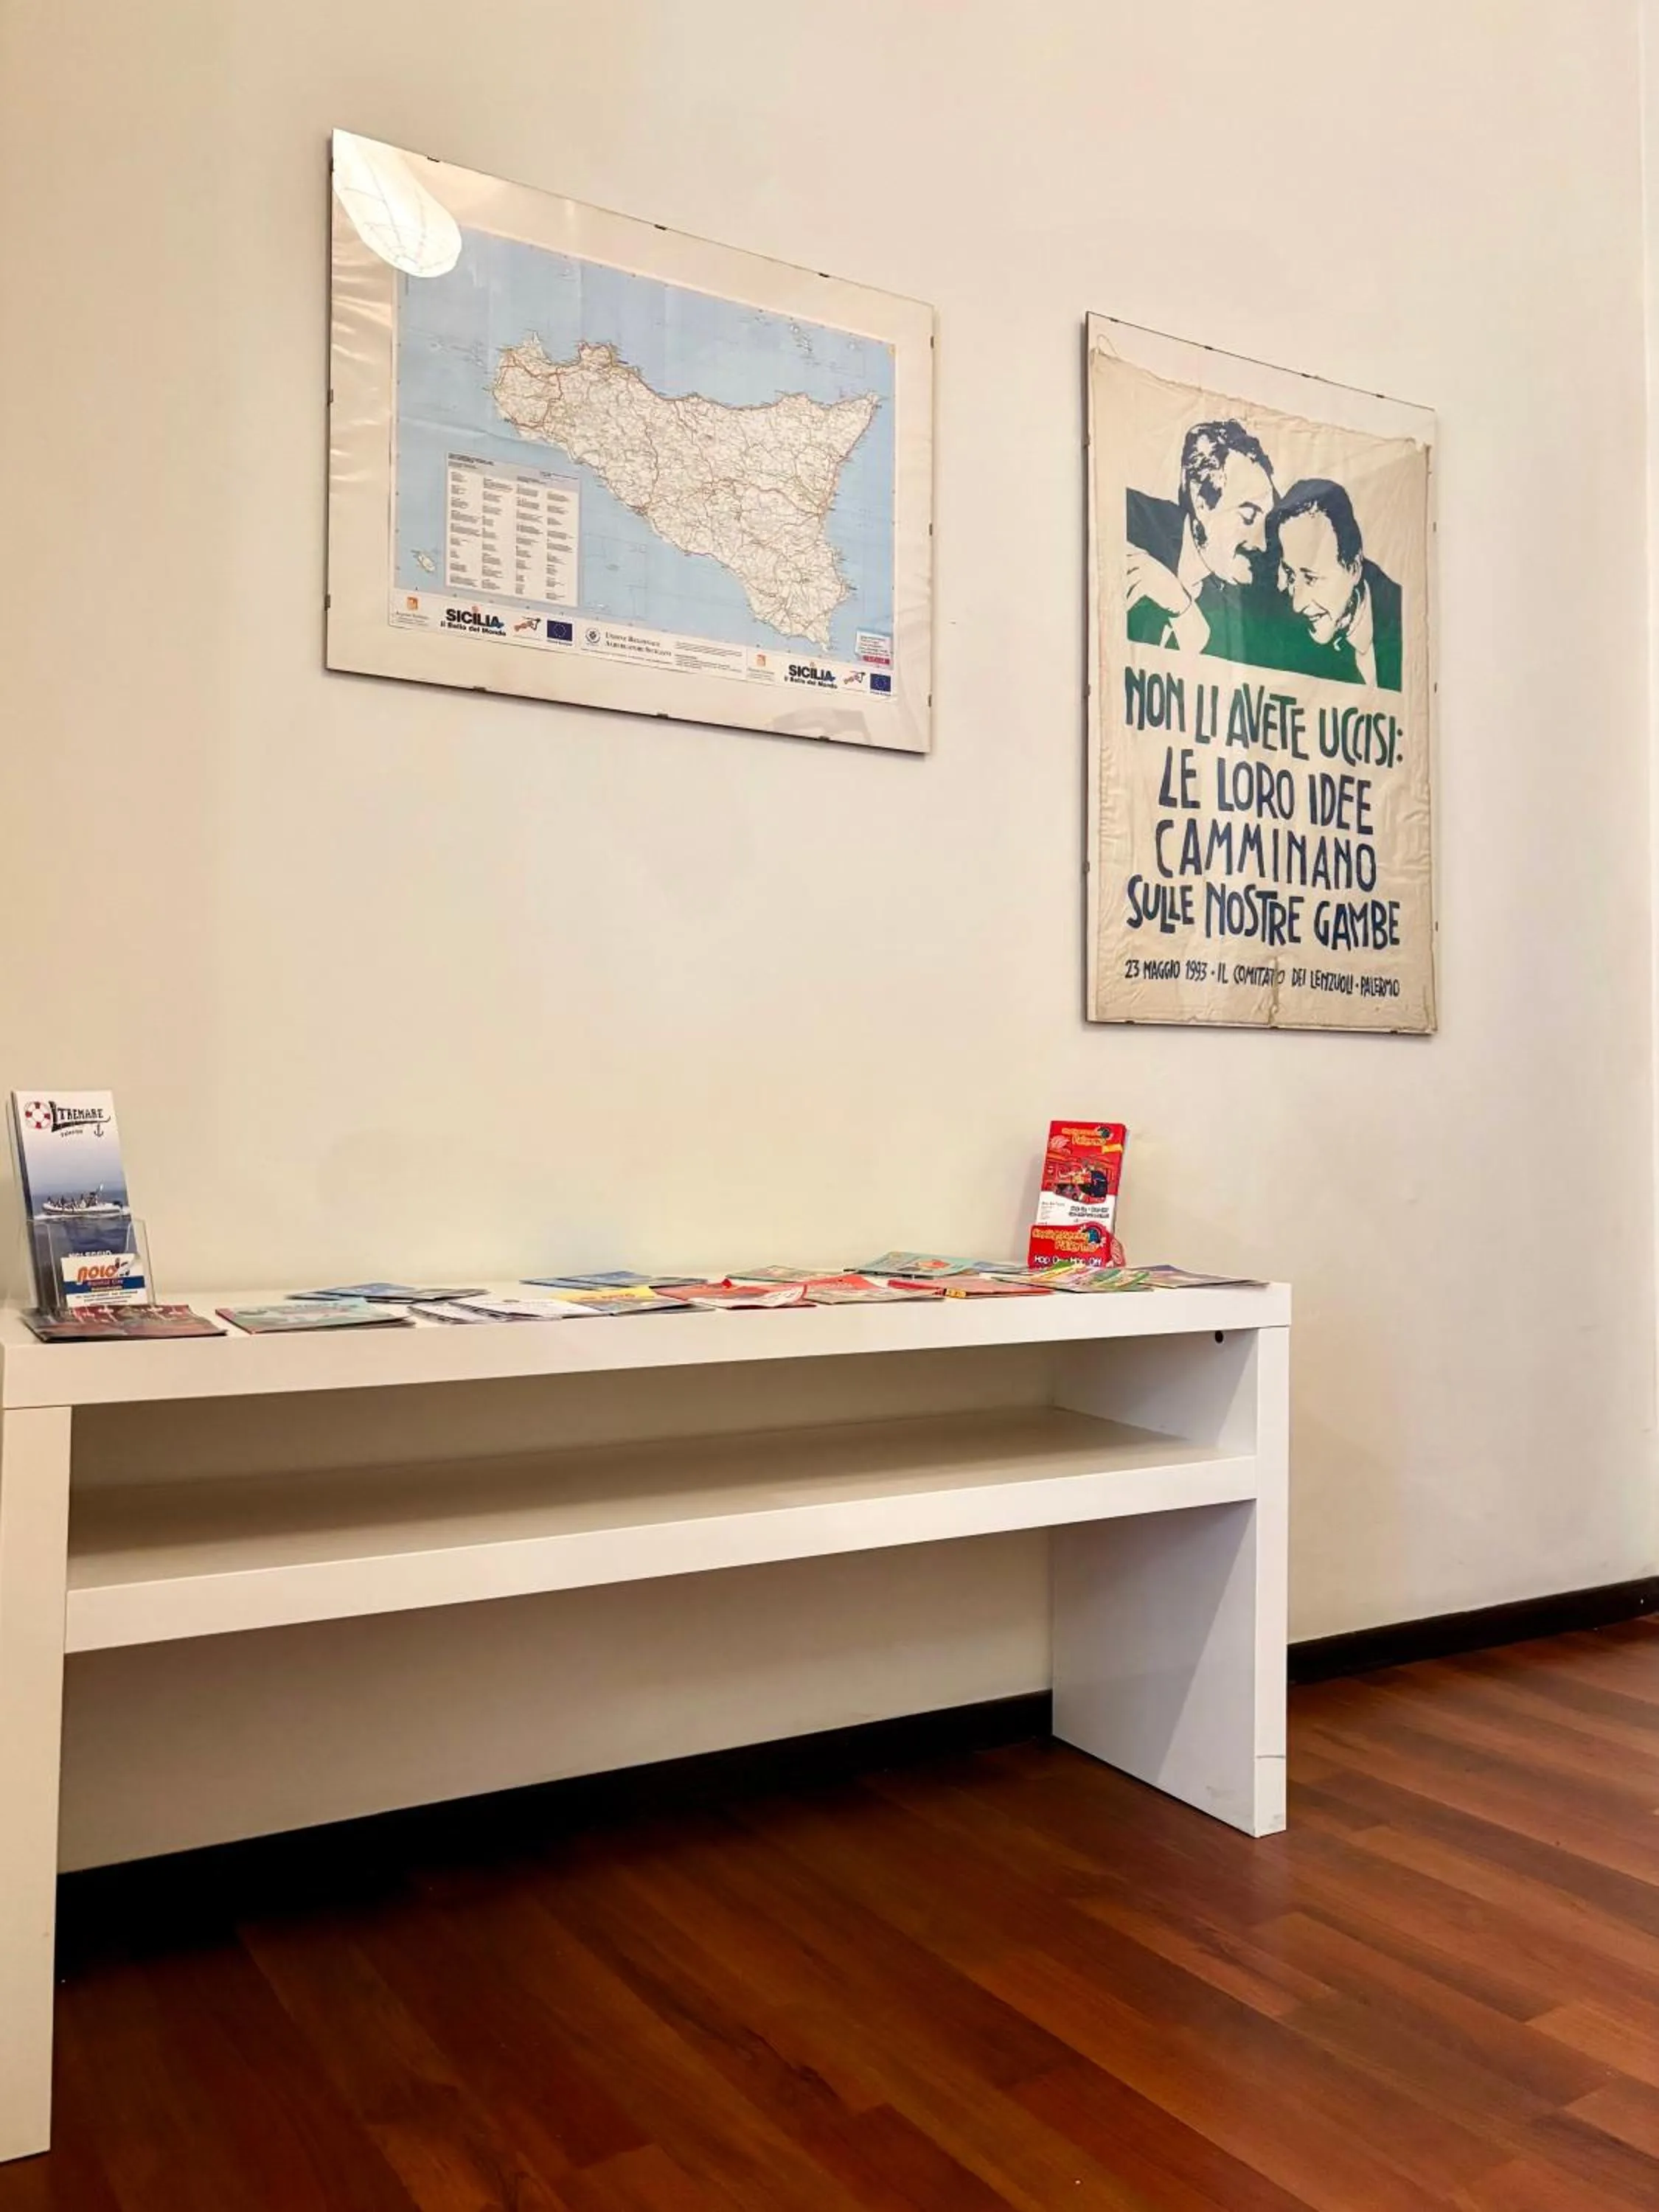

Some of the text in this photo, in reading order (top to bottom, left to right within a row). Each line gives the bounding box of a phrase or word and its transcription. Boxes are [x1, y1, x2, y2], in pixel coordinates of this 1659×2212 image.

[445, 607, 504, 629] SICILIA
[468, 624, 480, 633] del
[481, 626, 507, 636] Mondo
[788, 663, 835, 682] SICILIA
[1124, 666, 1403, 768] NON LI AVETE UCCISI:
[1158, 746, 1374, 835] LE LORO IDEE
[1155, 818, 1377, 892] CAMMINANO
[1126, 874, 1401, 951] SULLE NOSTRE GAMBE
[1124, 959, 1401, 997] 23 MAGGIO 1993 IL COMITATO DEI LENZUOLI PALERMO
